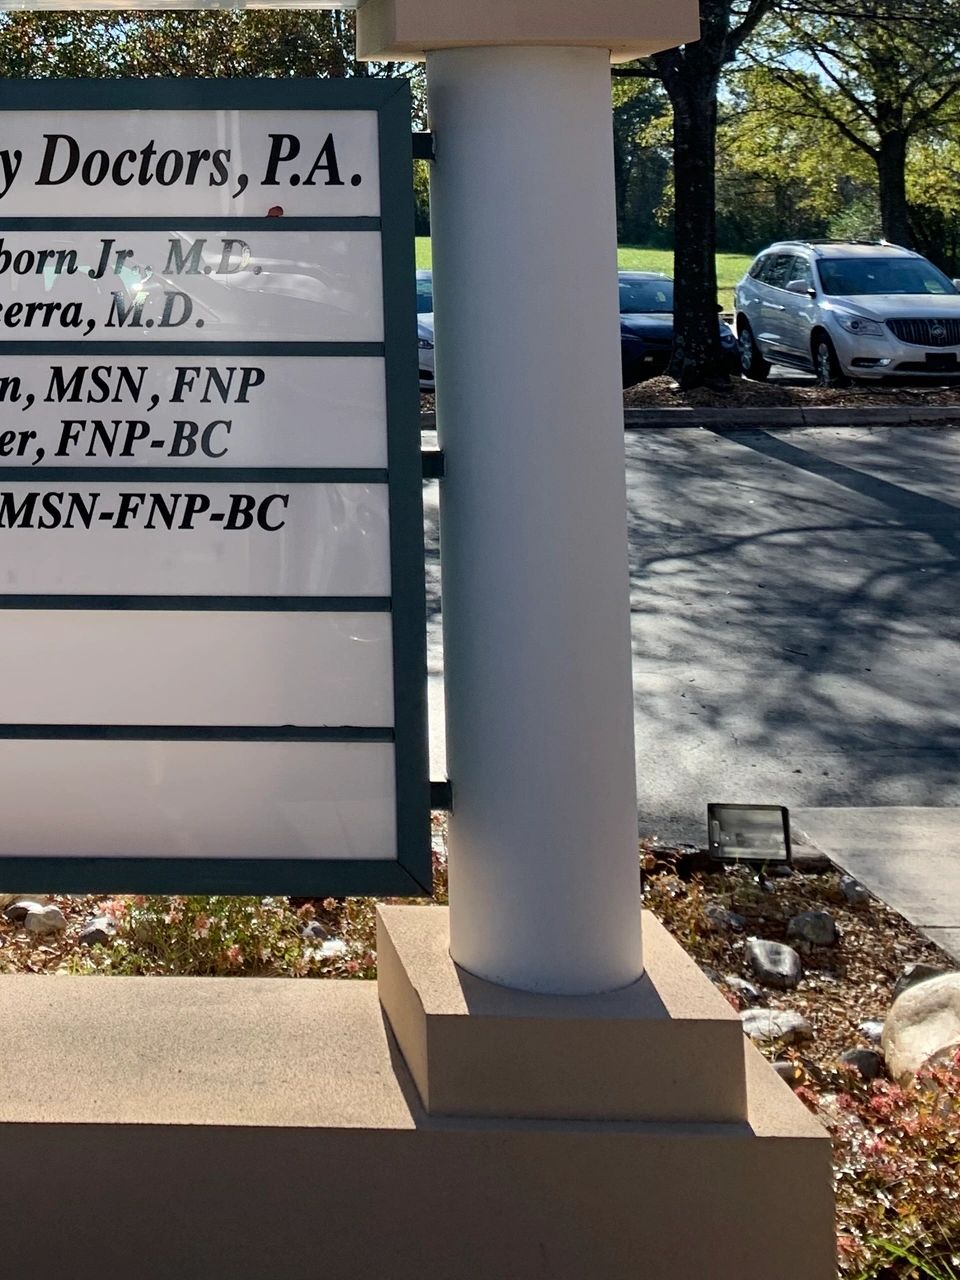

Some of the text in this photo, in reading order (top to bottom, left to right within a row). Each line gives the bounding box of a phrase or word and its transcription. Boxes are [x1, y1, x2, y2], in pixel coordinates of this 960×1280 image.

[35, 134, 248, 199] Doctors,
[261, 133, 362, 186] P.A.
[162, 239, 263, 275] M.D.
[105, 291, 205, 328] M.D.
[44, 366, 160, 411] MSN,
[169, 367, 266, 403] FNP
[54, 420, 232, 458] FNP-BC
